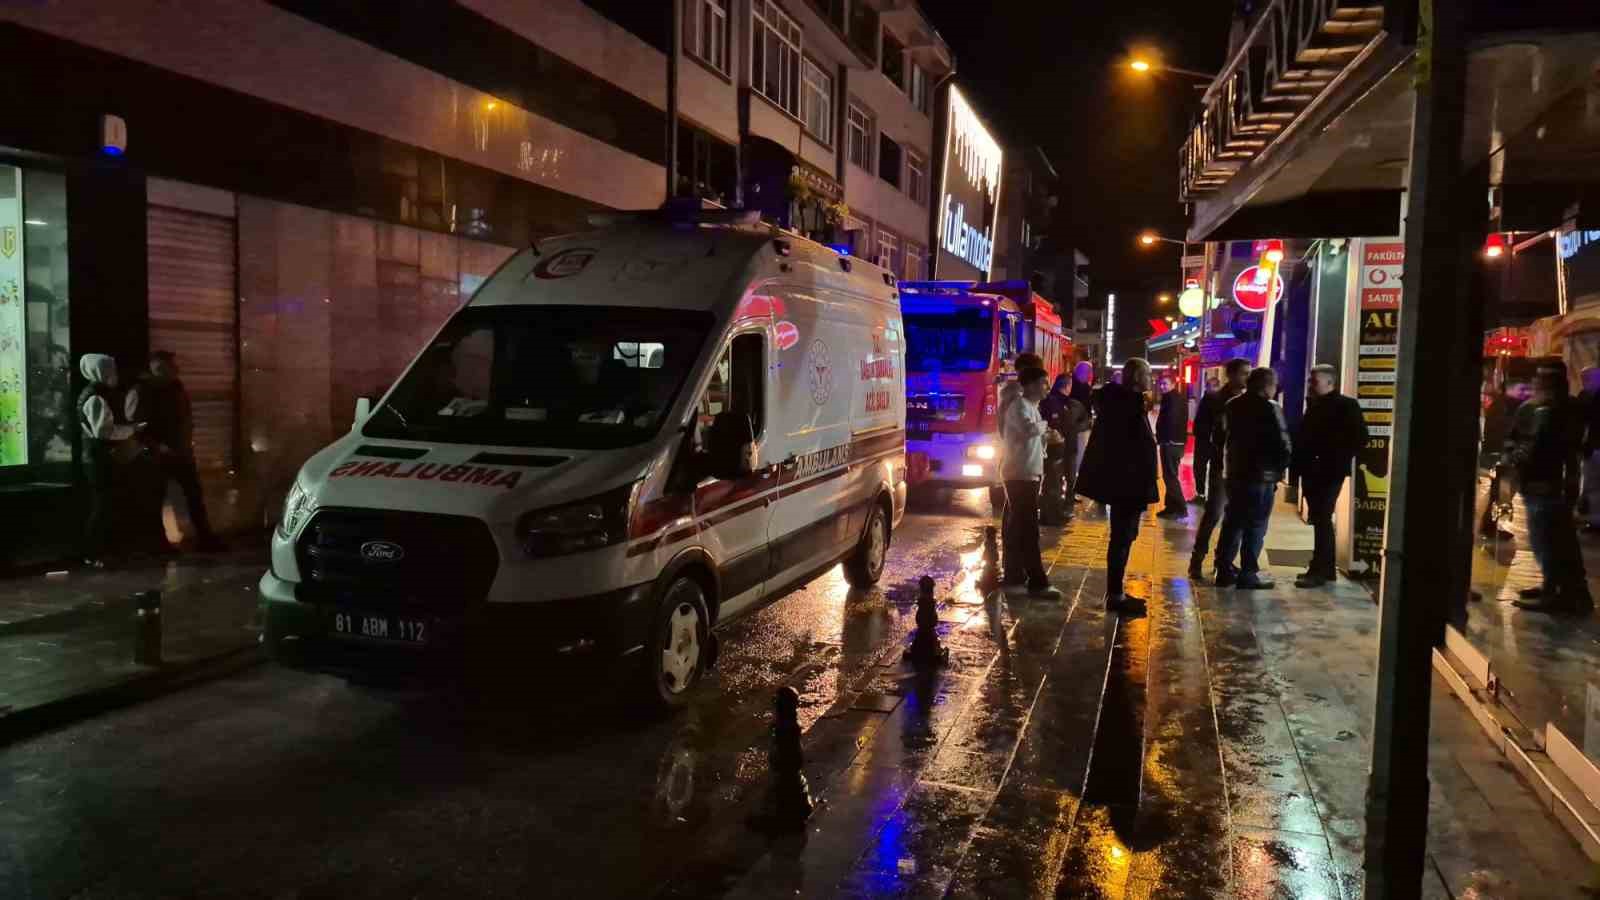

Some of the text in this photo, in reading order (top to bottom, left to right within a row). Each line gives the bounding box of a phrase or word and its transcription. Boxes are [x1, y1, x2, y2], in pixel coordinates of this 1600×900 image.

[943, 194, 992, 273] fullamoda
[366, 543, 396, 559] Ford
[399, 619, 425, 641] 112
